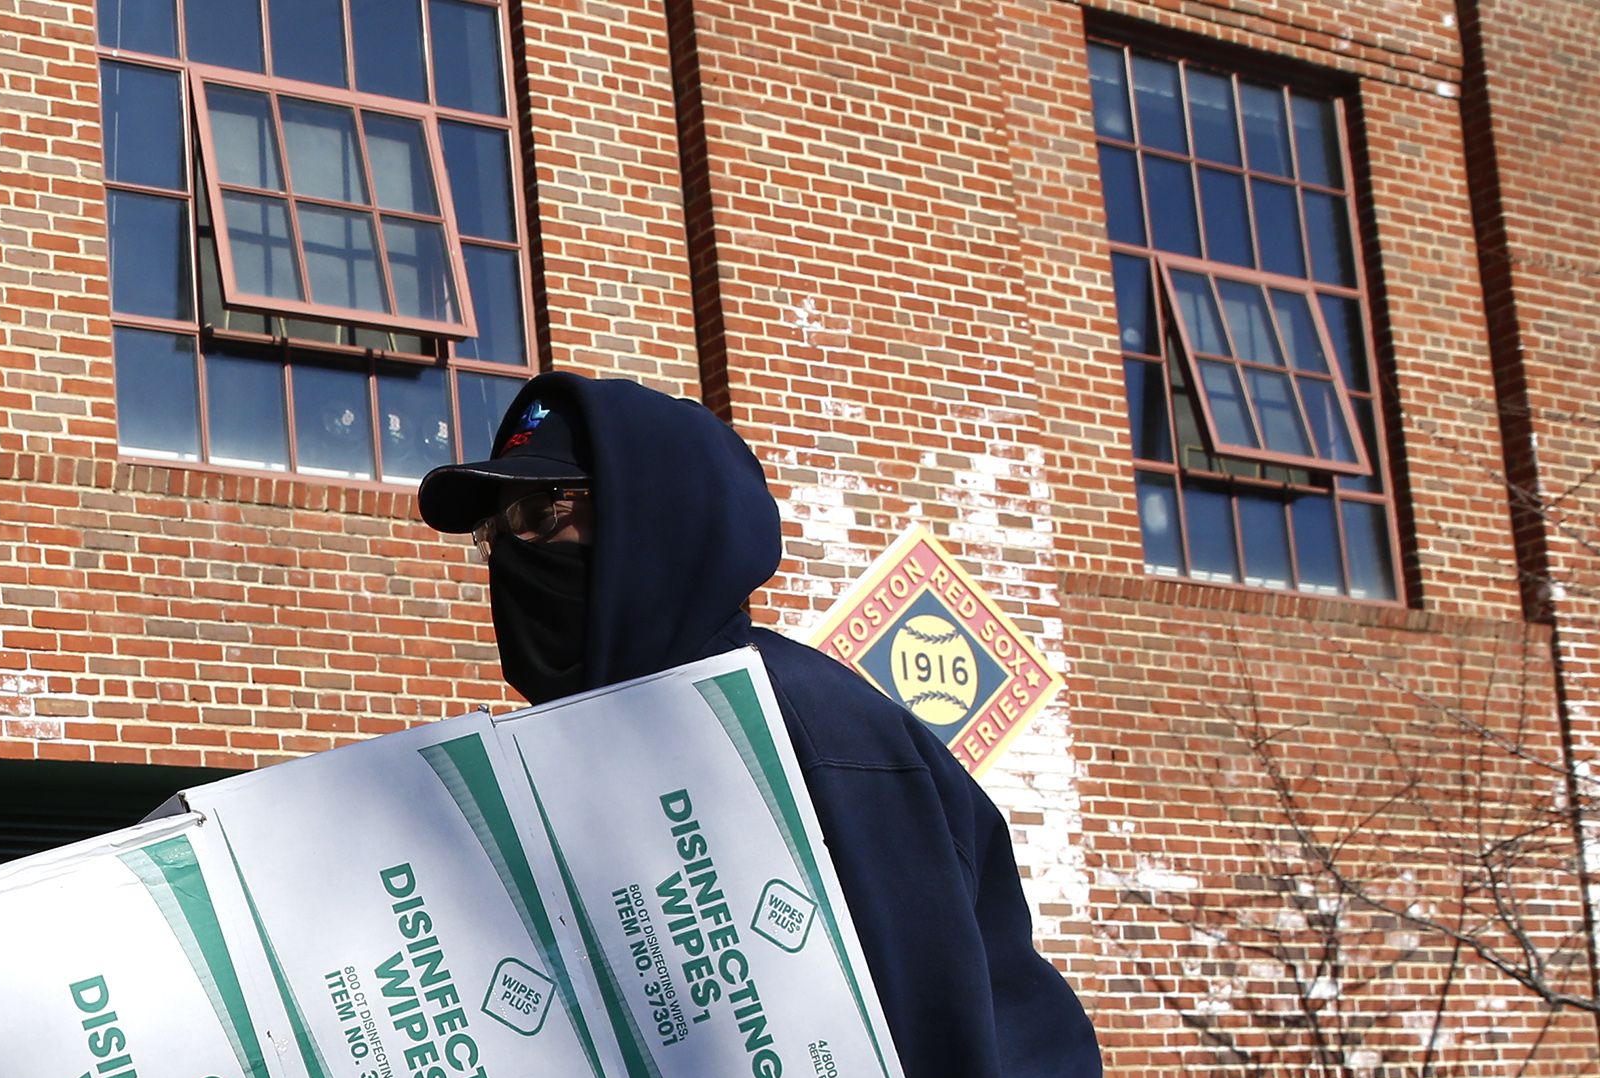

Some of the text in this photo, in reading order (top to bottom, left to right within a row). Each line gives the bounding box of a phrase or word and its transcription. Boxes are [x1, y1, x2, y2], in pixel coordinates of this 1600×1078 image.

[831, 556, 1029, 675] BOSTON RED SOX
[900, 650, 970, 686] 1916
[629, 884, 644, 907] 800
[769, 894, 804, 924] WIPES
[638, 909, 650, 922] CT
[612, 888, 678, 1046] ITEM NO. 37301
[643, 925, 676, 999] DISINFECTING
[344, 966, 361, 990] 800
[353, 991, 368, 1008] CT
[502, 974, 542, 1005] WIPES
[325, 970, 356, 1021] ITEM
[345, 1026, 368, 1065] NO.
[808, 1043, 823, 1074] REFILL
[818, 1040, 837, 1078] 4/800
